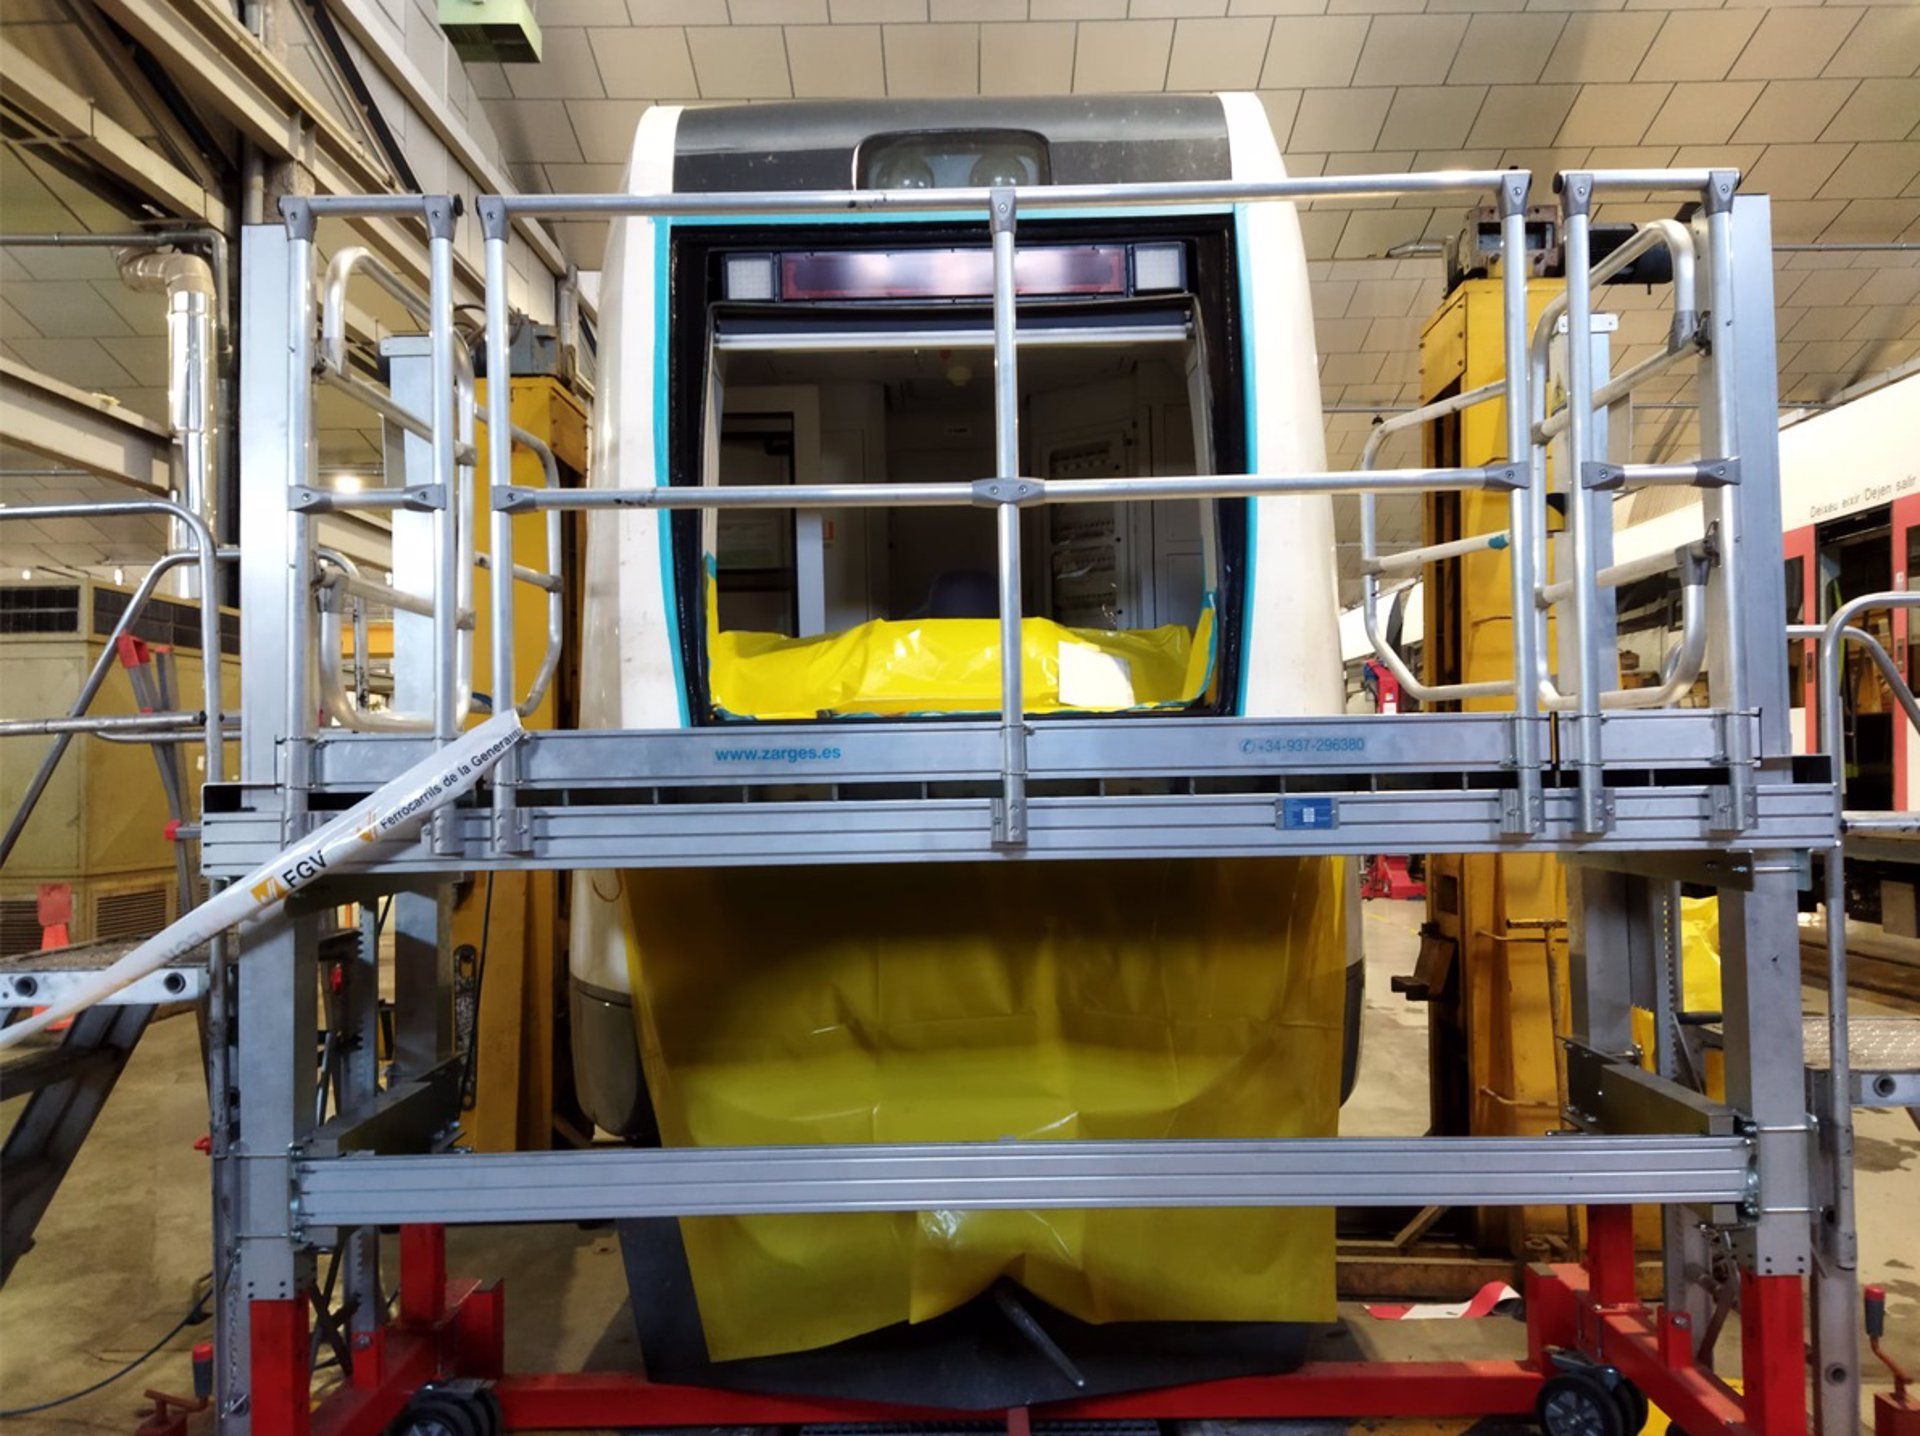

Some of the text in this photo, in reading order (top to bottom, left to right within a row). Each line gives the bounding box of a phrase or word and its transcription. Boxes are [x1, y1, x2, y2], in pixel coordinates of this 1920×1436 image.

[1864, 485, 1892, 502] Dejen
[1895, 474, 1917, 492] salir
[714, 747, 842, 764] www.zarges.es
[380, 784, 443, 830] Ferrocarrils
[442, 773, 459, 788] de
[457, 764, 472, 777] la
[282, 850, 327, 889] FGV
